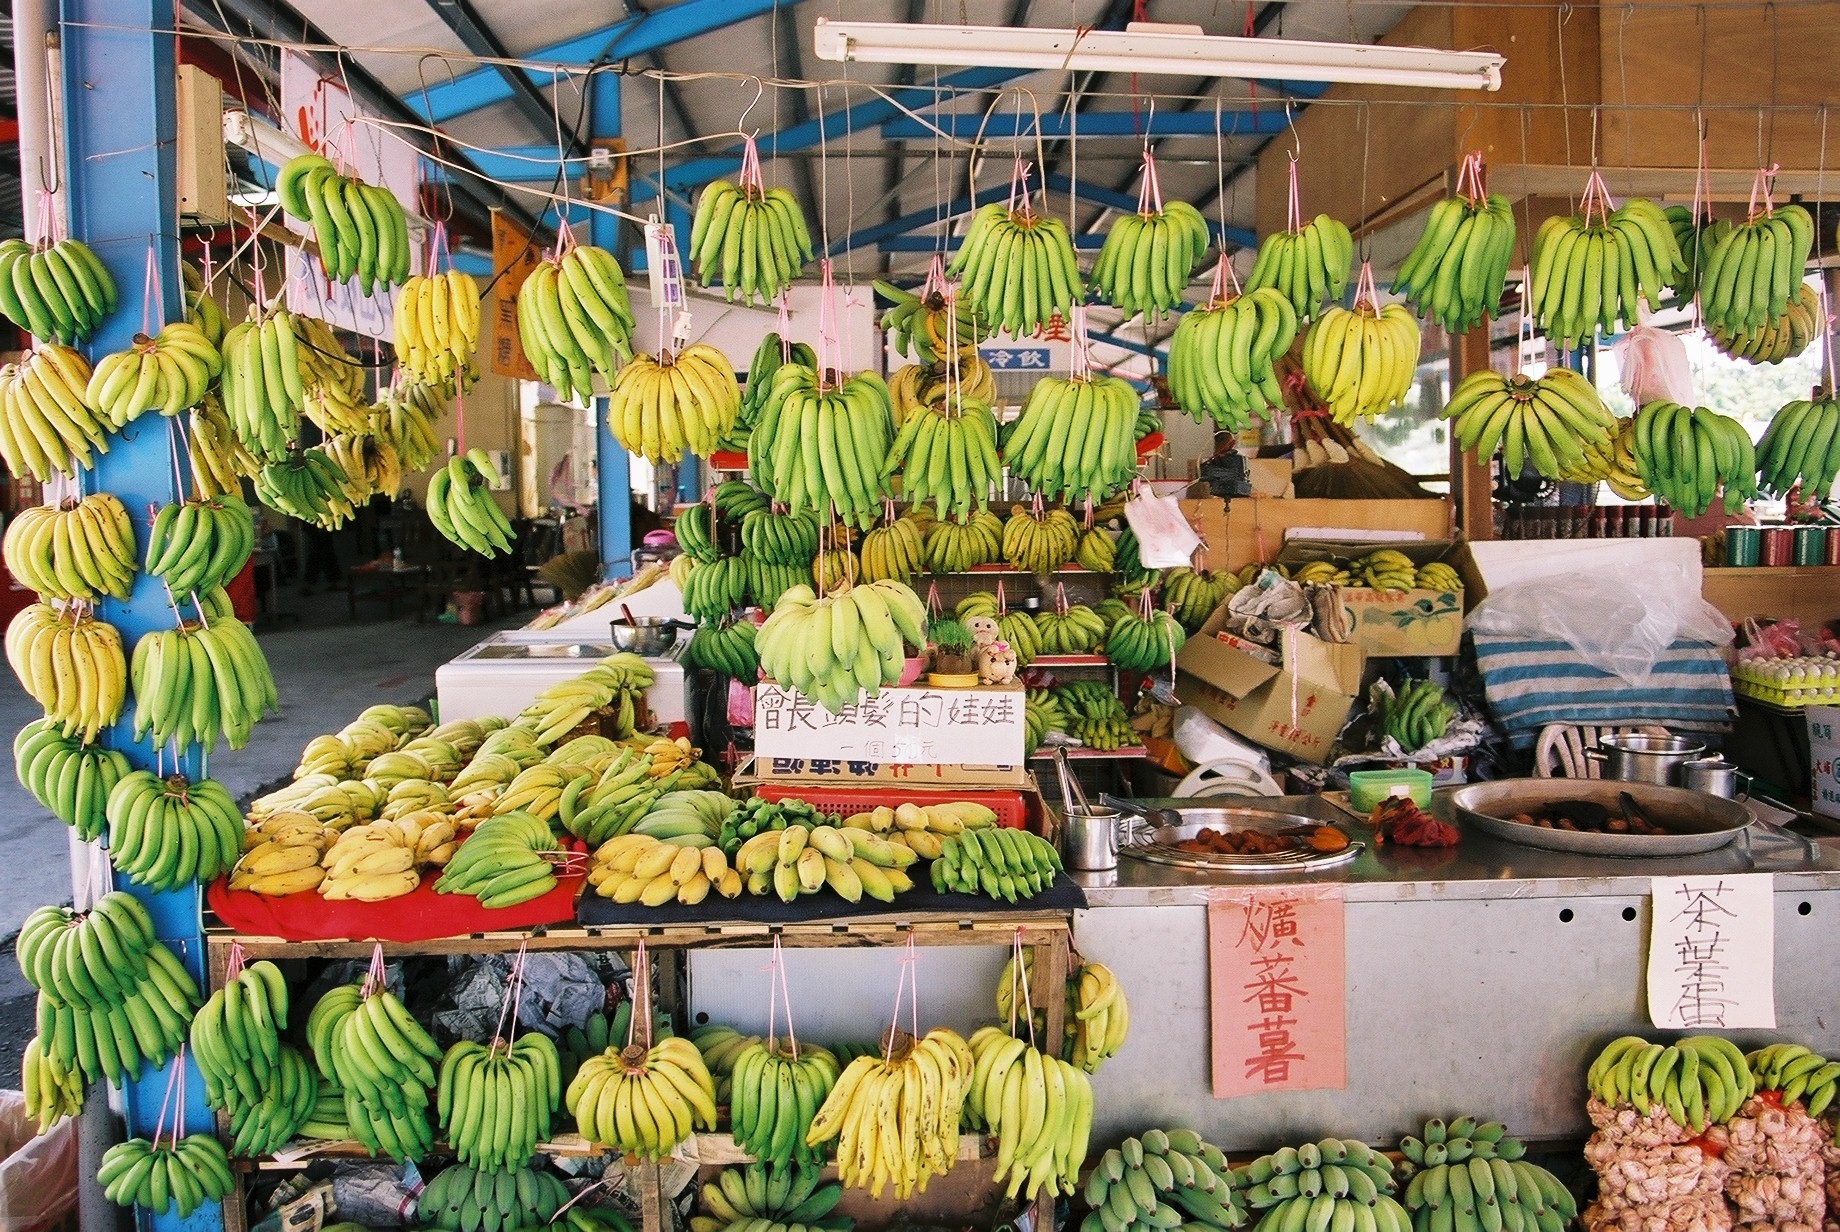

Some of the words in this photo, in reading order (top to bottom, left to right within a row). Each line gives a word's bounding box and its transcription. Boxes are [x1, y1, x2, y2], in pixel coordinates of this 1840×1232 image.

[988, 349, 1046, 368] 冷飲
[1669, 880, 1740, 1028] 茶葉蛋
